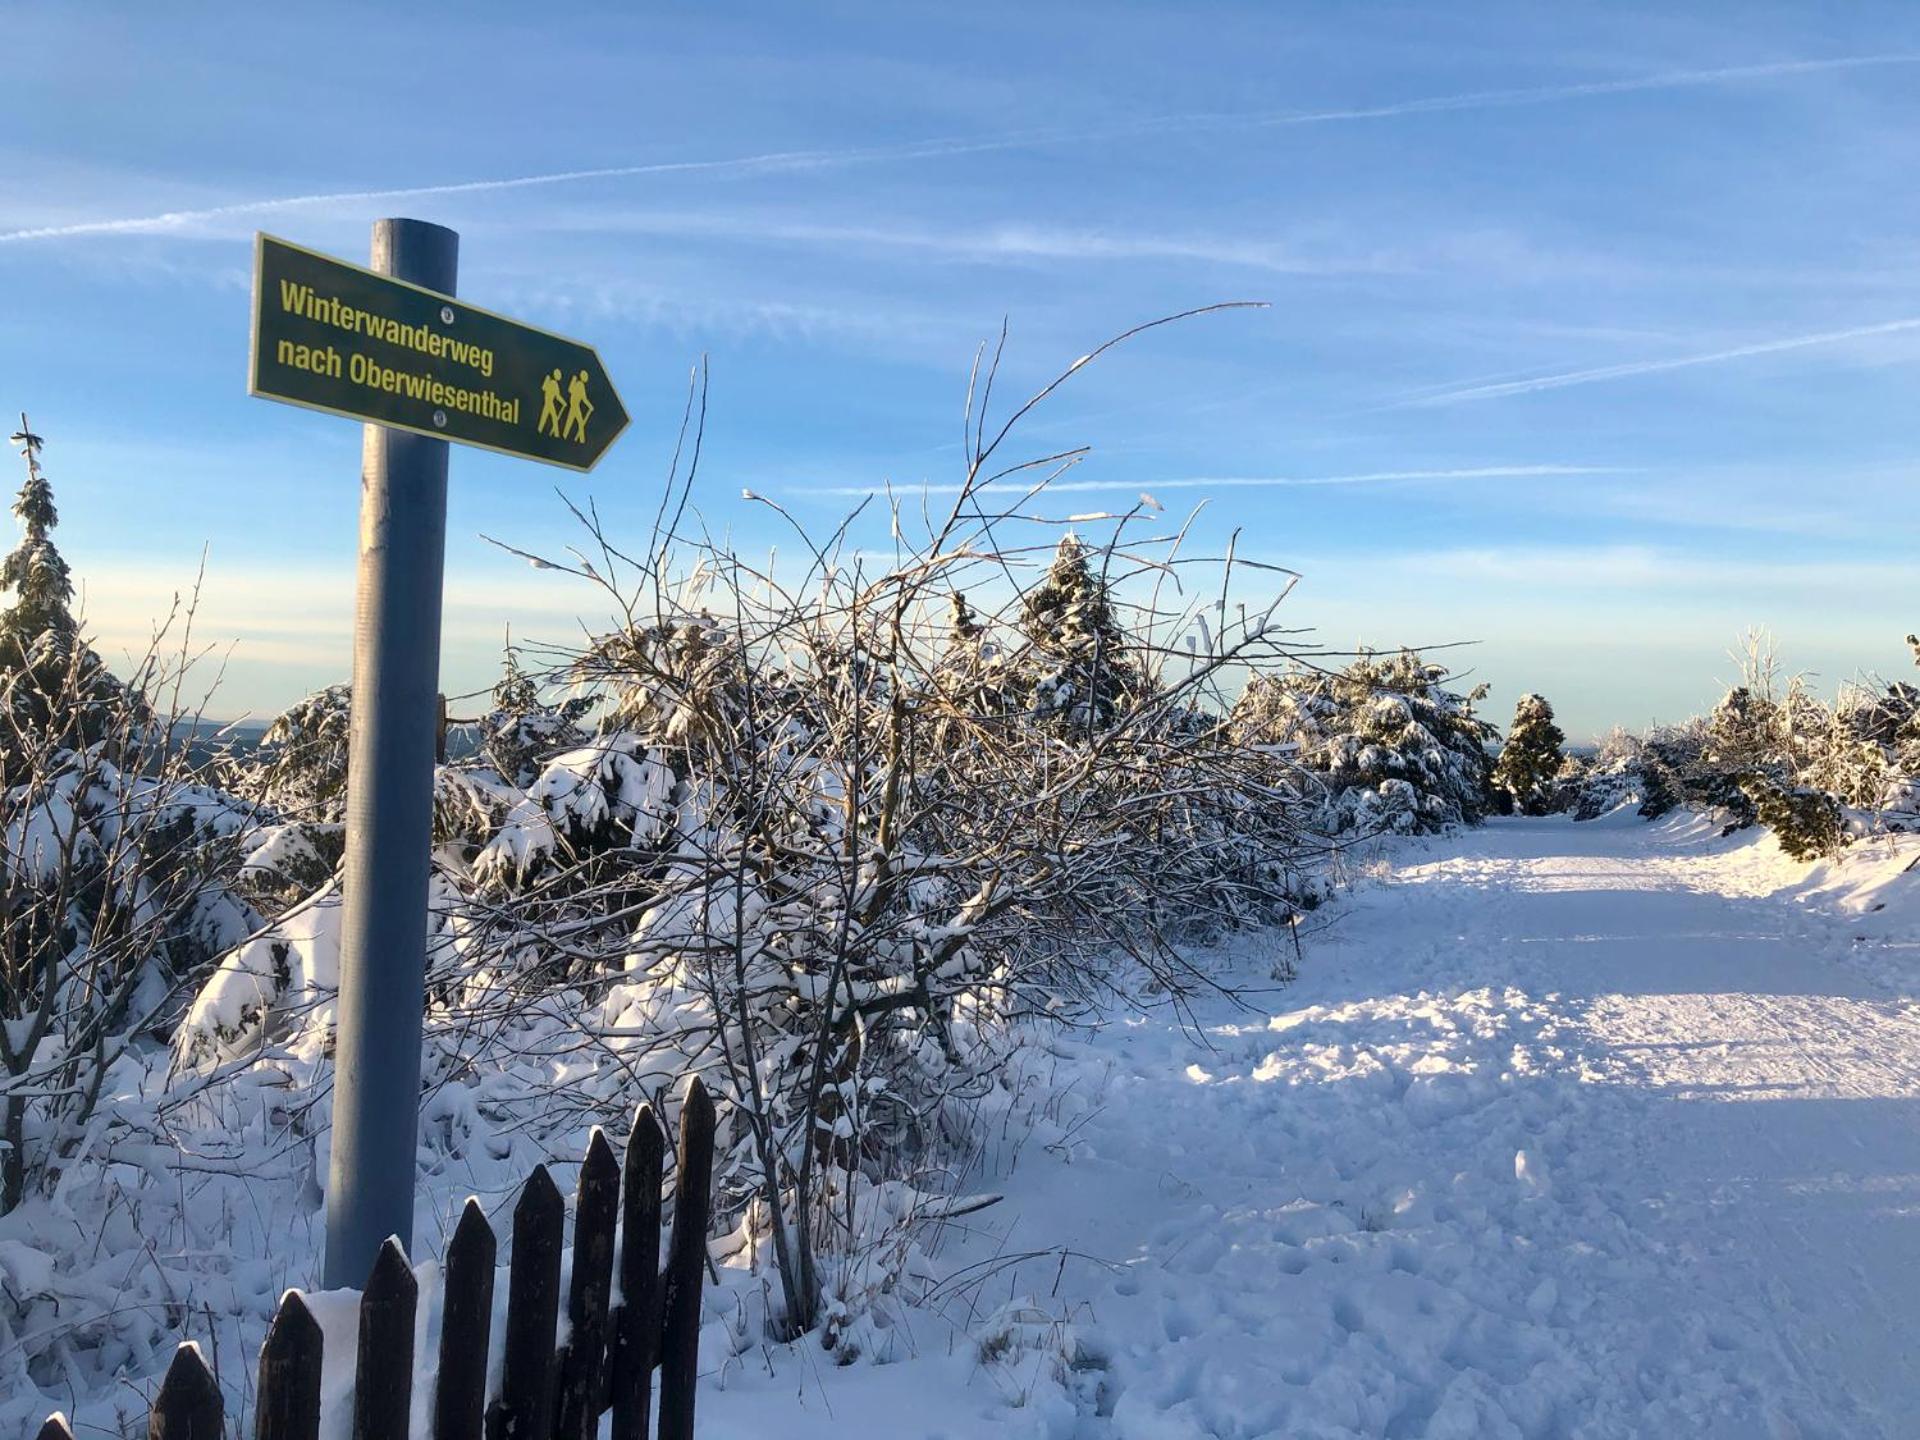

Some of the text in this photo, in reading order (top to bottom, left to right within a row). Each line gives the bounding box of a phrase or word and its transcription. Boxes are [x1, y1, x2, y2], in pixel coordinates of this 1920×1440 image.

[280, 279, 494, 377] Winterwanderweg
[277, 339, 519, 424] nach Oberwiesenthal
